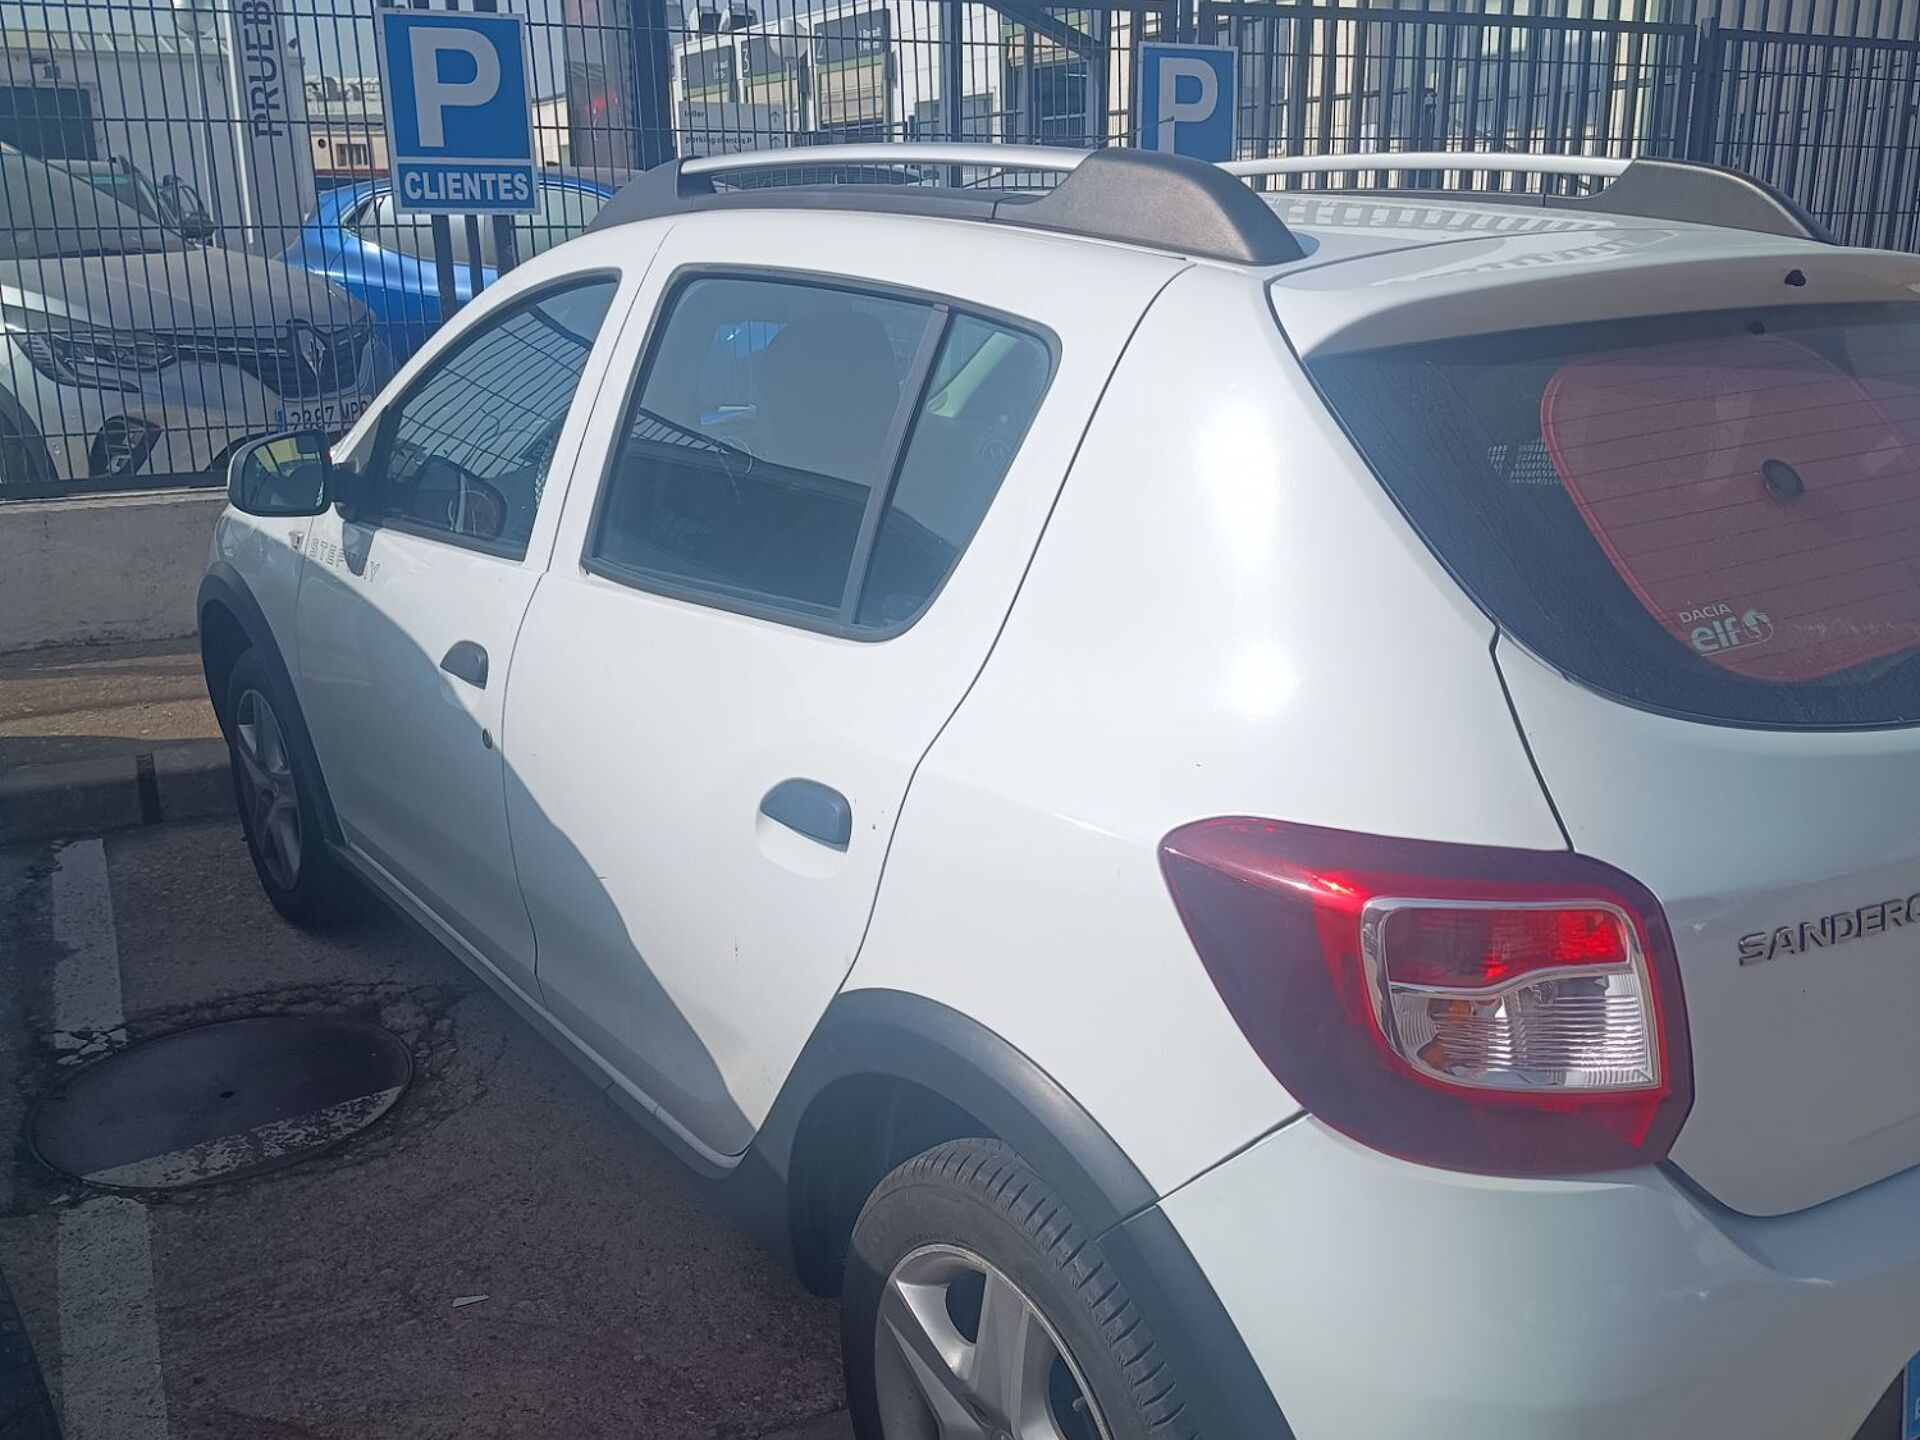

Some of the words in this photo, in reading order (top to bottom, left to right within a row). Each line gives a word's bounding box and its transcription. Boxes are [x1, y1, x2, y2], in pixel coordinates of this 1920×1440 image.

[408, 25, 501, 148] P
[1157, 56, 1218, 155] P
[404, 171, 530, 201] CLIENTES
[1678, 603, 1732, 623] DACIA
[1690, 616, 1742, 652] elf
